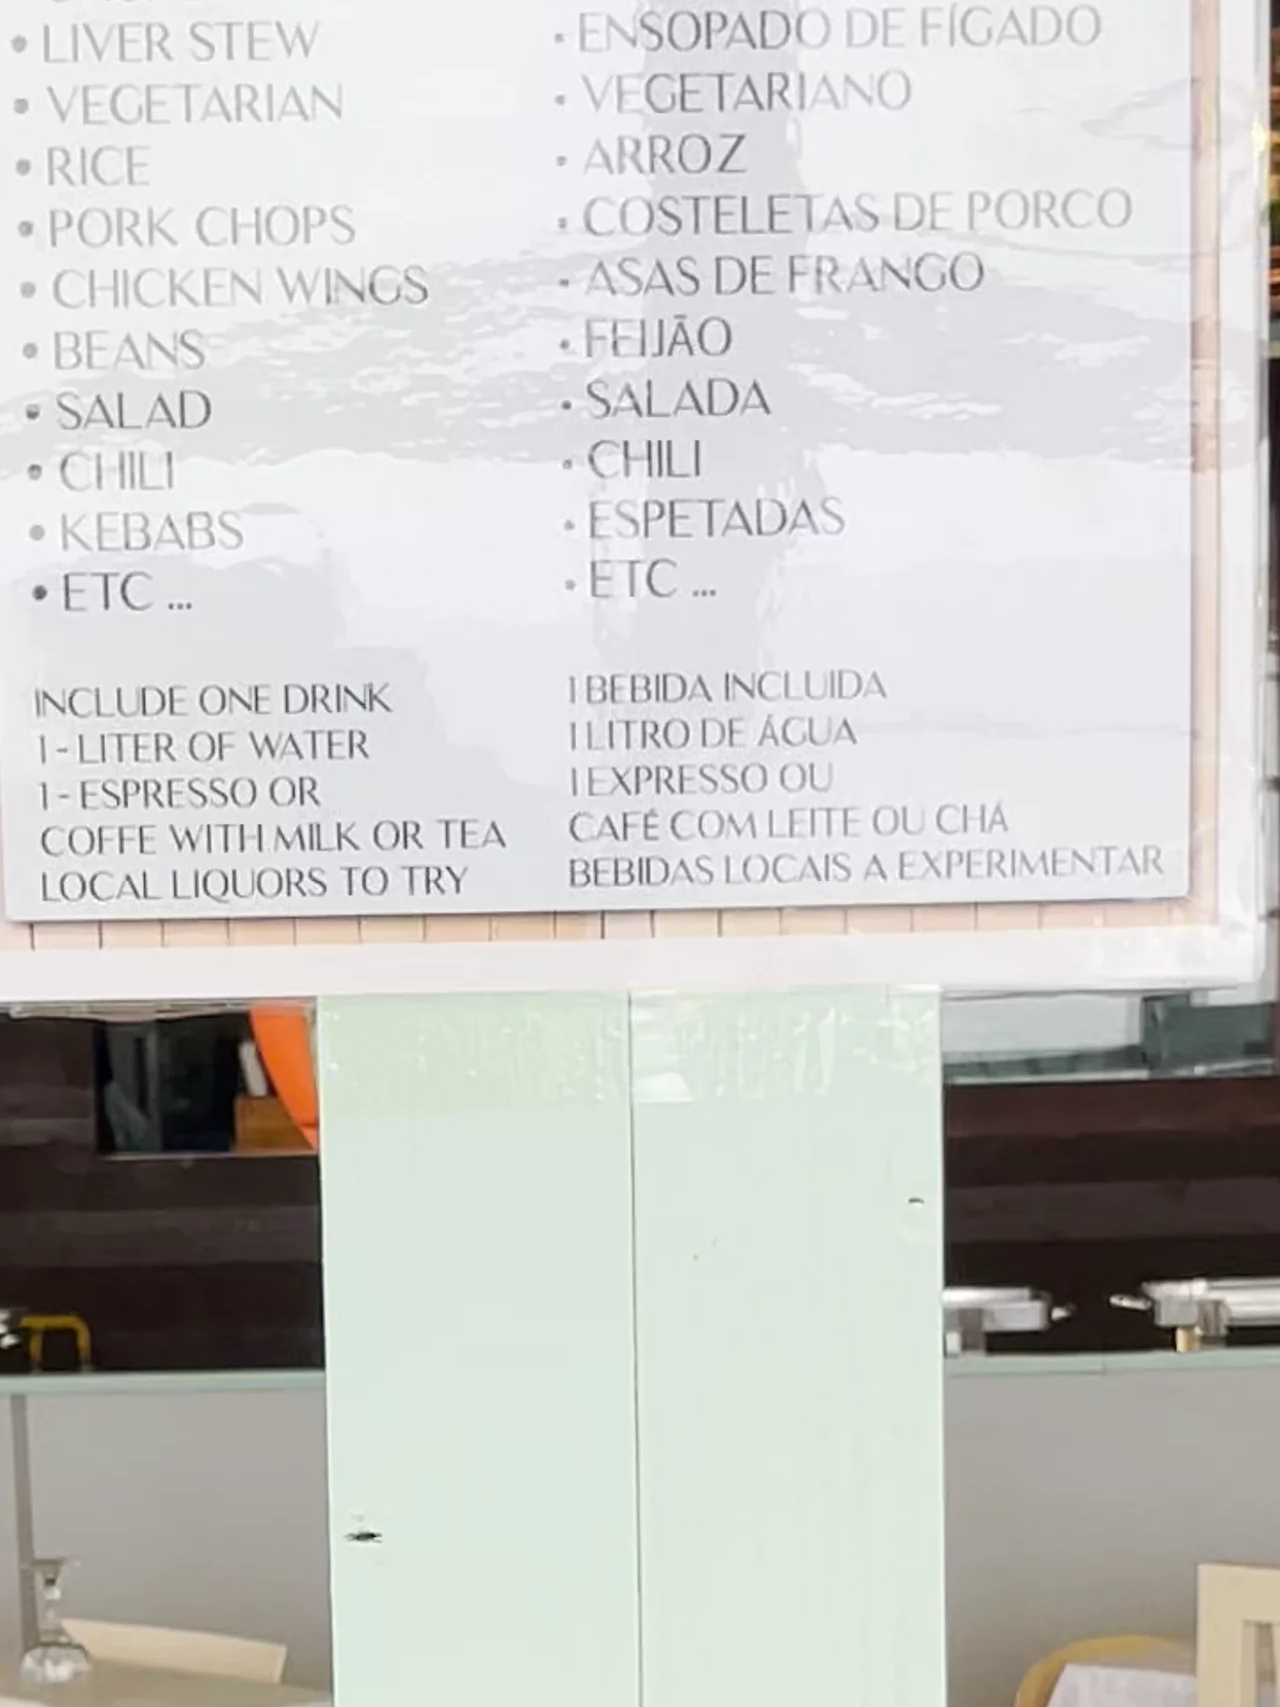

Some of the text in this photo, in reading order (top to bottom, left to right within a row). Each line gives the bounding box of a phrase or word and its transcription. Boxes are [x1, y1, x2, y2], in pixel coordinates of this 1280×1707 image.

[42, 21, 320, 63] LIVER STEW
[578, 8, 830, 53] ENSOPADO
[846, 8, 905, 48] DE
[46, 83, 344, 125] VEGETARIAN
[581, 70, 912, 114] VEGETARIANO
[46, 146, 152, 186] RICE
[583, 133, 747, 175] ARROZ
[48, 205, 356, 248] PORK CHOPS
[583, 189, 1133, 236] COSTELETAS DE PORCO
[52, 266, 429, 309] CHICKEN WINGS
[585, 252, 985, 296] ASAS DE FRANGO
[53, 329, 206, 370] BEANS
[585, 315, 733, 357] FEIJÃO
[57, 390, 211, 430] SALAD
[586, 378, 771, 419] SALADA
[60, 450, 174, 492] CHILI
[587, 439, 702, 479] CHILI
[60, 511, 244, 552] KEBABS
[589, 498, 846, 540] ESPETADAS
[62, 571, 154, 611] ETC
[590, 558, 677, 597] ETC
[34, 682, 393, 718] INCLUDE ONE DRINK
[586, 672, 712, 704] BEBIDA
[724, 668, 887, 702] INCLUIDA
[38, 735, 48, 764] 1
[77, 733, 176, 764] LITER
[188, 731, 236, 762] OF
[249, 729, 369, 761] WATER
[586, 718, 689, 750] LITRO
[701, 717, 746, 748] DE
[758, 714, 857, 747] ÁGUA
[38, 781, 48, 811] 1
[80, 777, 256, 810] ESPRESSO
[269, 775, 321, 807] OR
[588, 762, 767, 796] EXPRESSO
[779, 761, 833, 793] OU
[42, 818, 506, 857] COFFE WITH MILK OR TEA
[569, 799, 1008, 842] CAFÉ COM LEITE OU CHÁ
[42, 864, 469, 904] LOCAL LIQUORS TO TRY
[569, 844, 1163, 888] BEBIDAS LOCAIS A EXPERIMENTAR
